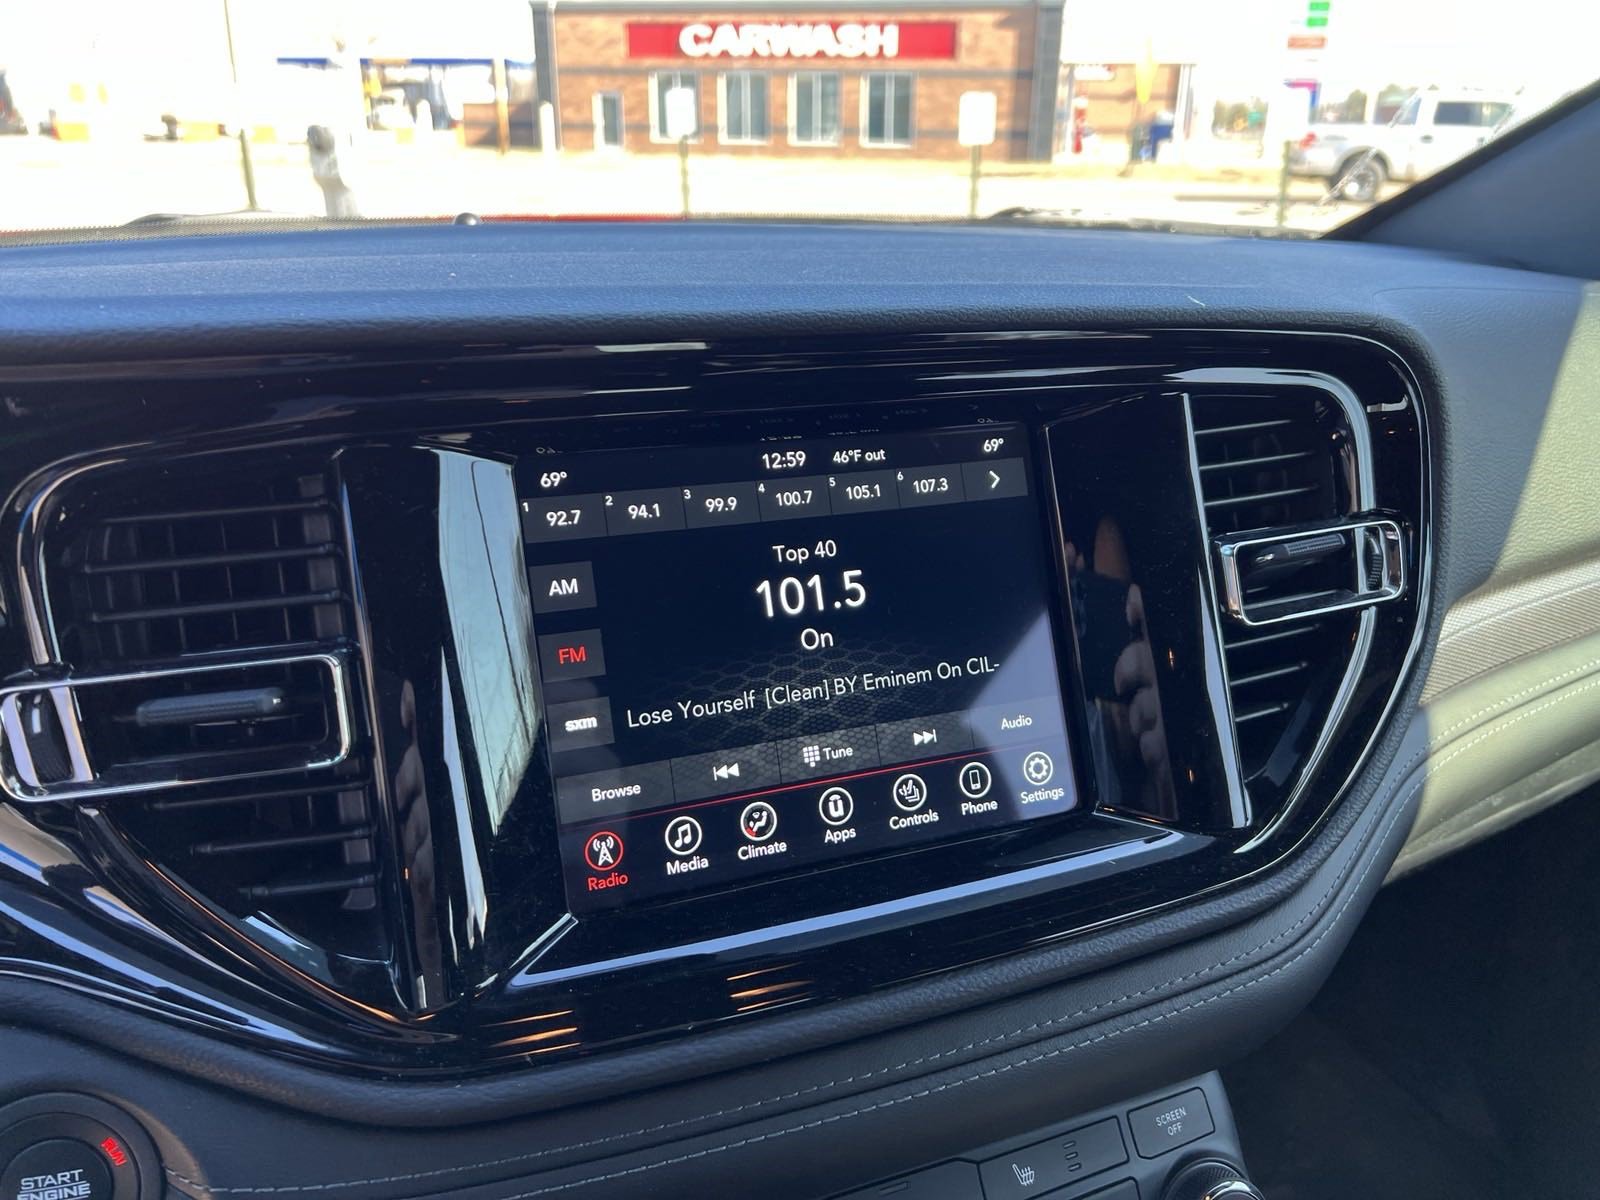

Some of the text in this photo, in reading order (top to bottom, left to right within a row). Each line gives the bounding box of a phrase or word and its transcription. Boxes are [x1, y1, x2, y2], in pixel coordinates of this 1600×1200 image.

[679, 24, 899, 57] CARWASH
[983, 437, 1004, 453] 69°
[762, 450, 806, 470] 12:59
[832, 448, 886, 464] 46°F out
[540, 471, 568, 488] 69°
[828, 476, 836, 487] 5
[897, 471, 904, 481] 6
[758, 483, 766, 493] 4
[845, 483, 881, 500] 105.1
[913, 477, 949, 494] 107.3
[605, 495, 614, 506] 2
[683, 489, 692, 500] 3
[775, 489, 813, 507] 100.7
[522, 502, 529, 513] 1
[627, 503, 661, 520] 94.1
[705, 496, 738, 513] 99.9
[546, 509, 581, 527] 92.7
[771, 539, 837, 565] Top 40
[548, 578, 579, 597] AM
[756, 569, 866, 618] 101.5
[800, 627, 834, 651] On
[558, 646, 586, 665] FM
[627, 709, 673, 728] Lose
[677, 690, 756, 719] Yourself
[764, 679, 830, 710] [Clean]
[833, 675, 858, 696] BY
[862, 669, 933, 691] Eminem
[936, 662, 962, 680] On
[1000, 714, 1033, 731] Audio
[822, 747, 854, 761] Tune
[591, 784, 641, 803] Browse
[1020, 786, 1065, 805] Settings
[960, 799, 998, 816] Phone
[889, 811, 939, 830] Controls
[824, 827, 857, 844] Apps
[737, 841, 787, 861] Climate
[666, 857, 709, 875] Media
[587, 873, 629, 891] Radio
[1155, 1106, 1187, 1126] SCREEN
[1166, 1122, 1183, 1136] OFF
[101, 1137, 127, 1166] RUN
[21, 1169, 83, 1190] START
[17, 1183, 91, 1200] ENGINE
